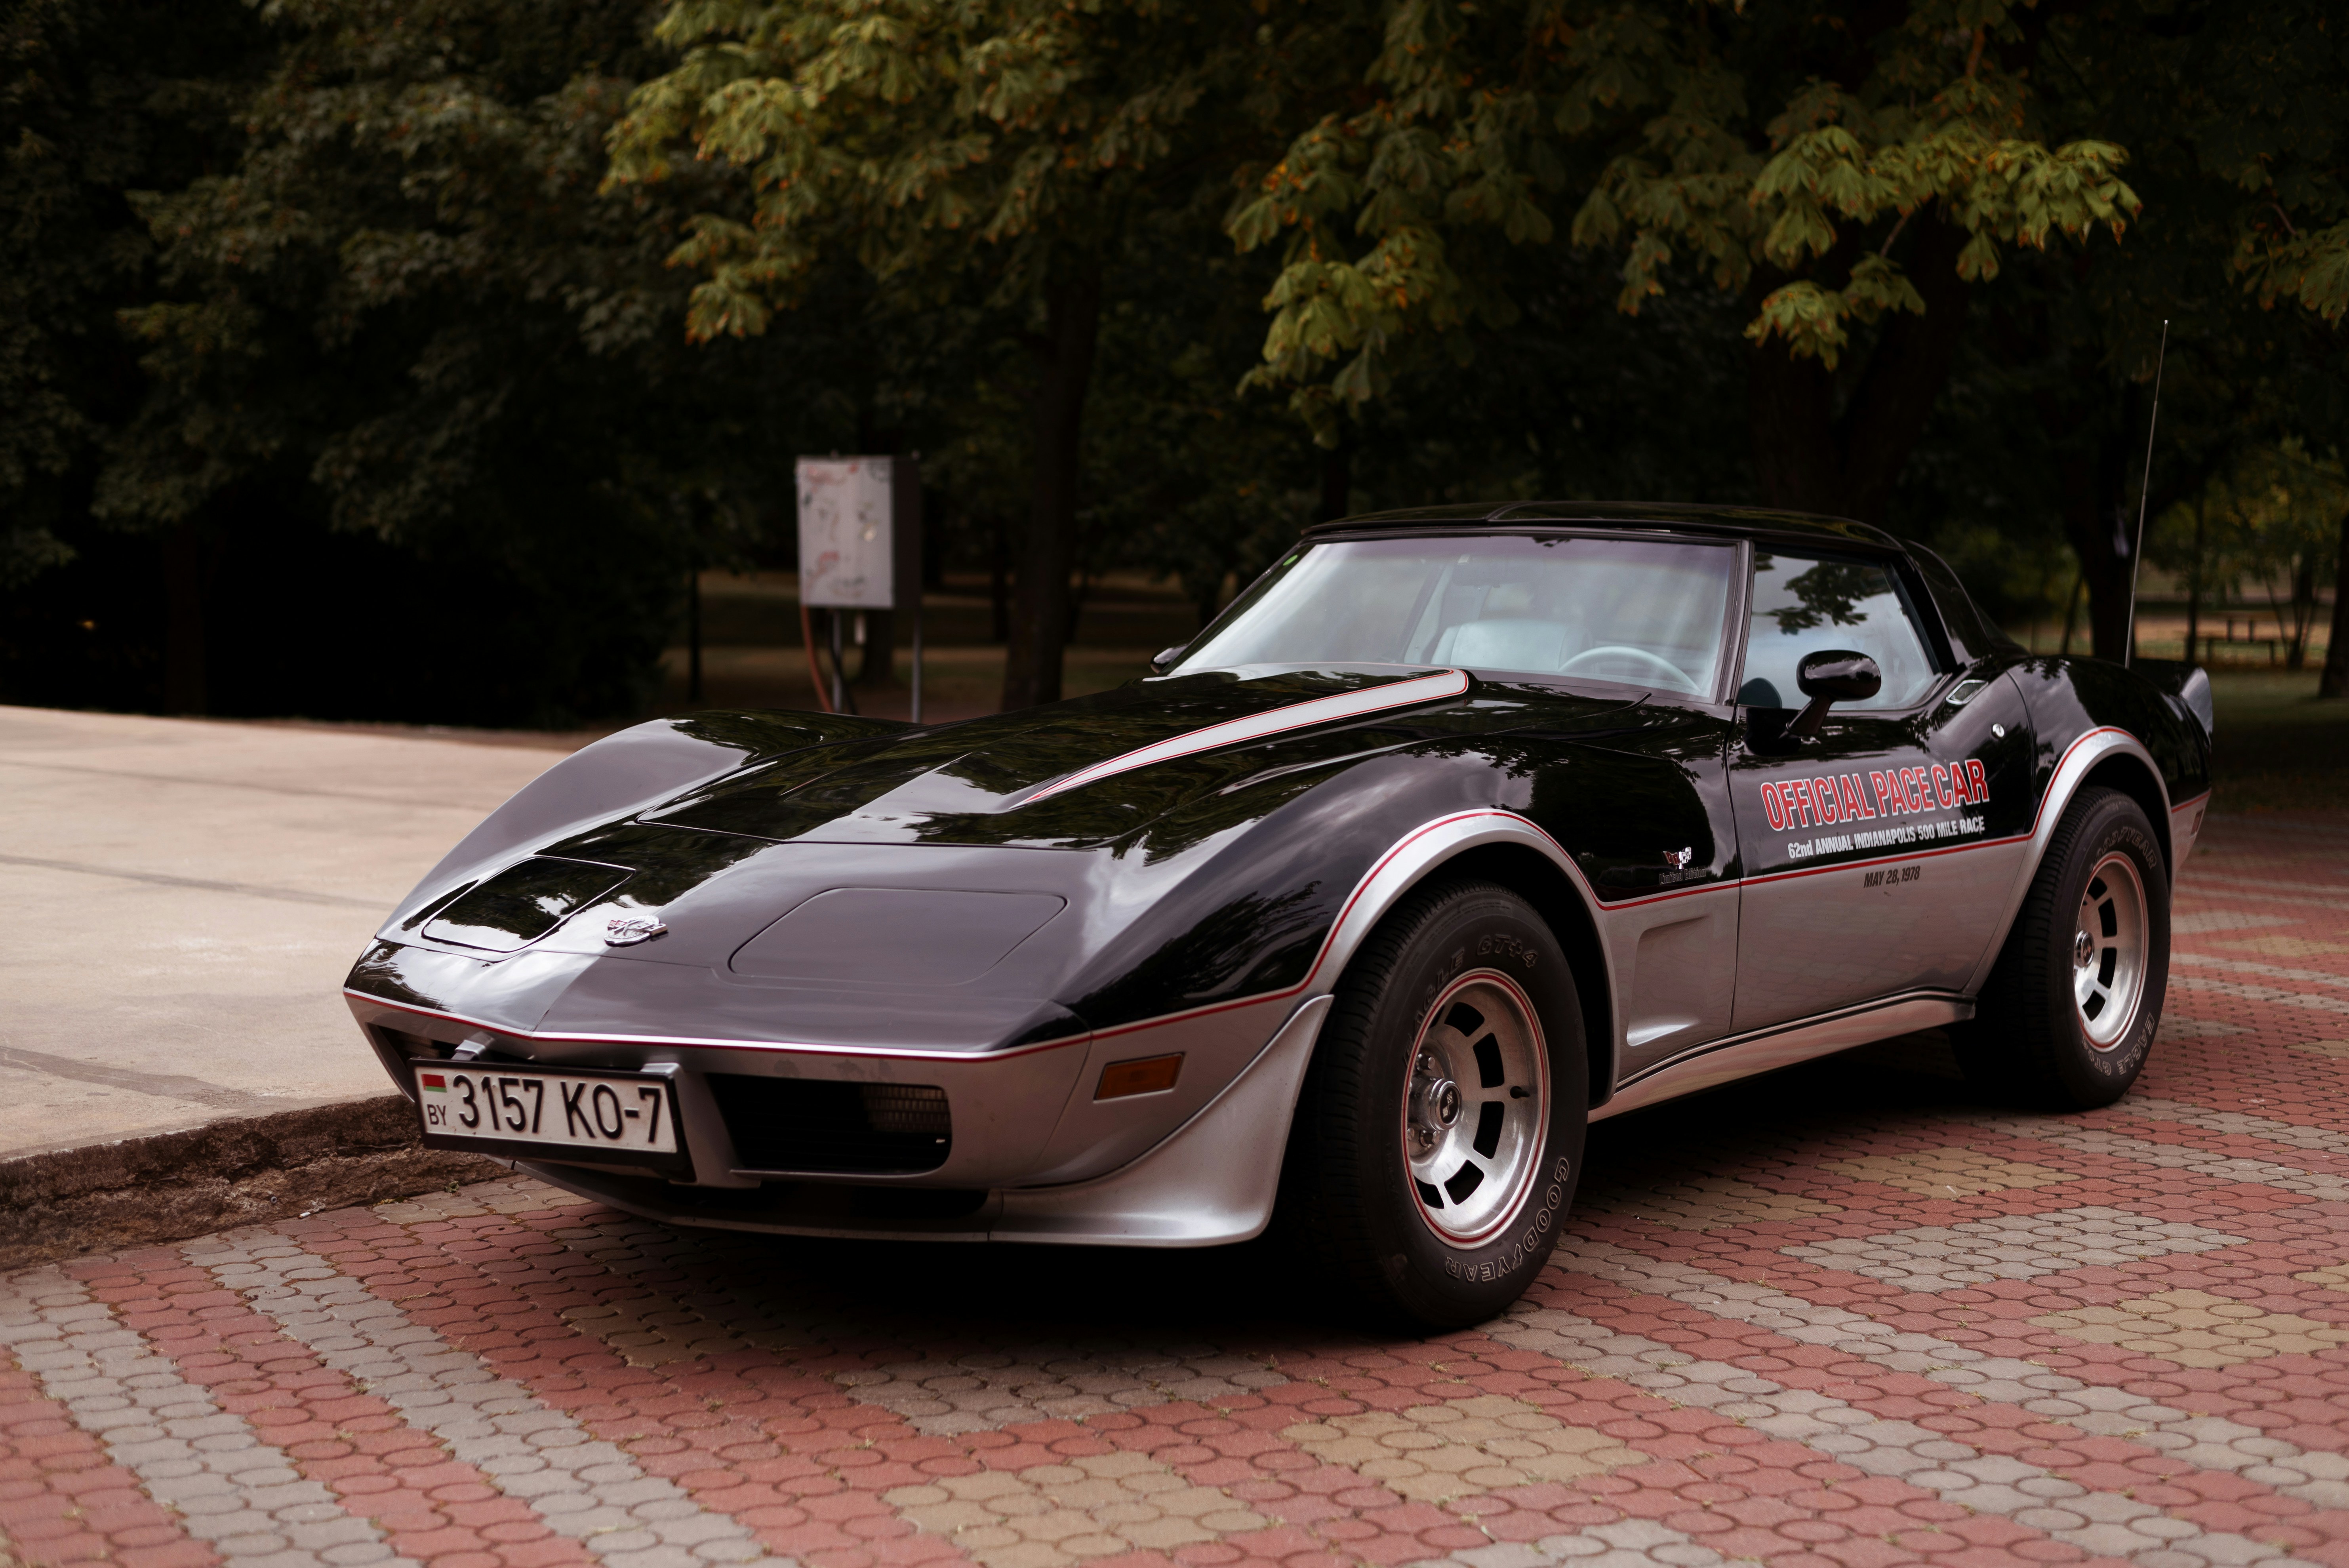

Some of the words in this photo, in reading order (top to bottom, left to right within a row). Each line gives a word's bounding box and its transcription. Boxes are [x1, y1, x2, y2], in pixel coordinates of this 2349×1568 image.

[1760, 773, 1876, 831] OFFICIAL
[1869, 766, 1935, 817] PACE
[1930, 759, 1989, 810] CAR
[1788, 842, 1813, 859] 62nd
[1816, 834, 1853, 855] ANNUAL
[1854, 828, 1916, 849] INDIANAPOLIS
[1918, 825, 1935, 840] 500
[1937, 820, 1958, 838] MILE
[1960, 816, 1985, 834] RACE
[1659, 869, 1683, 885] Limited
[1684, 867, 1706, 880] Edition
[1863, 871, 1884, 888] MAY
[1886, 869, 1899, 886] 28,
[1901, 866, 1920, 881] 1978
[1477, 934, 1539, 969] GT+4
[2117, 1012, 2155, 1075] EAGLE
[427, 1104, 446, 1126] BY
[453, 1074, 543, 1134] 3157
[561, 1080, 661, 1143] KO-7
[1445, 1157, 1569, 1282] GOODYEAR
